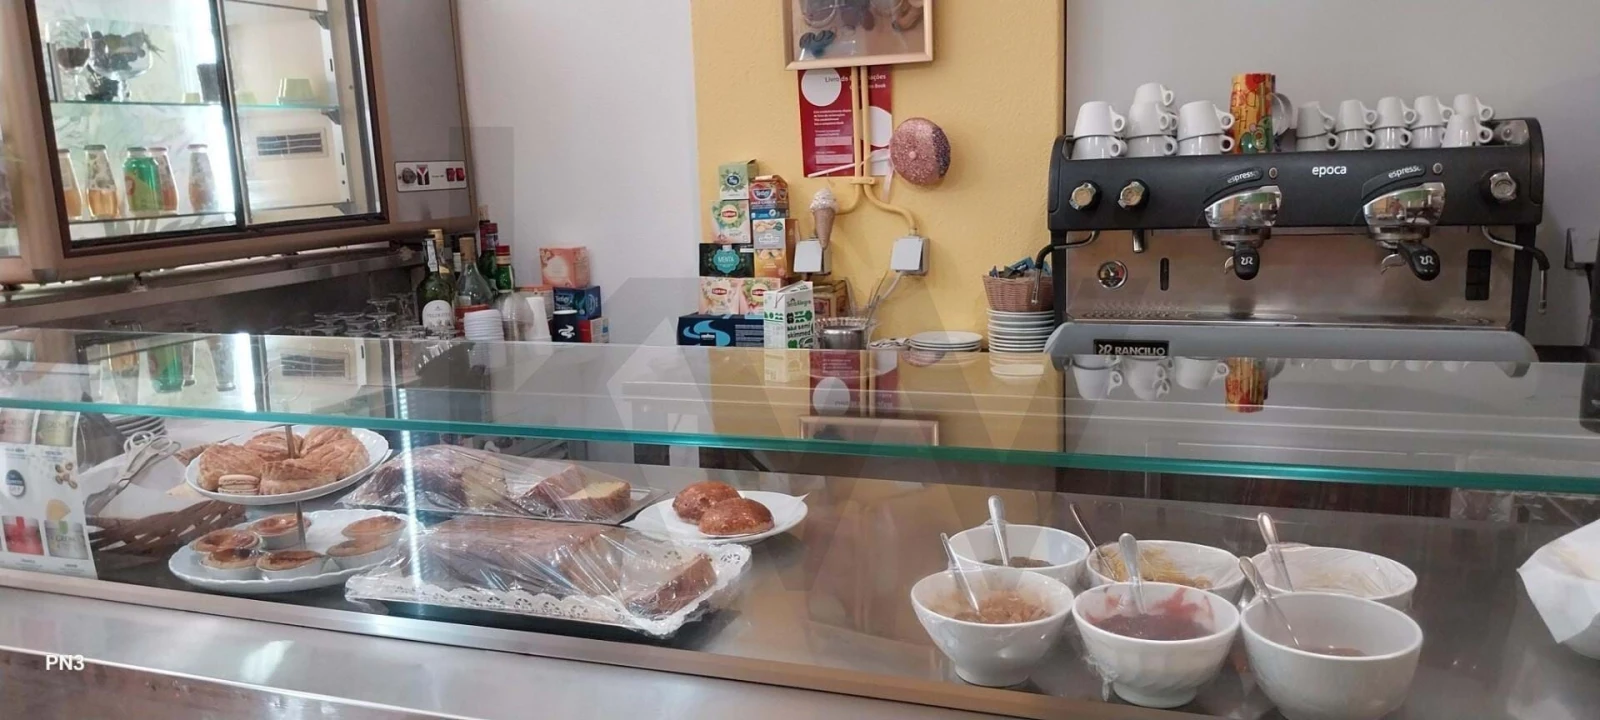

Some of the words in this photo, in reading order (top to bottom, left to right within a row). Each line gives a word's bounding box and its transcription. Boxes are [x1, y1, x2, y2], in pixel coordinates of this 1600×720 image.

[1311, 165, 1347, 178] epoca
[717, 255, 735, 263] MENTA
[1114, 346, 1166, 356] RANCILIO
